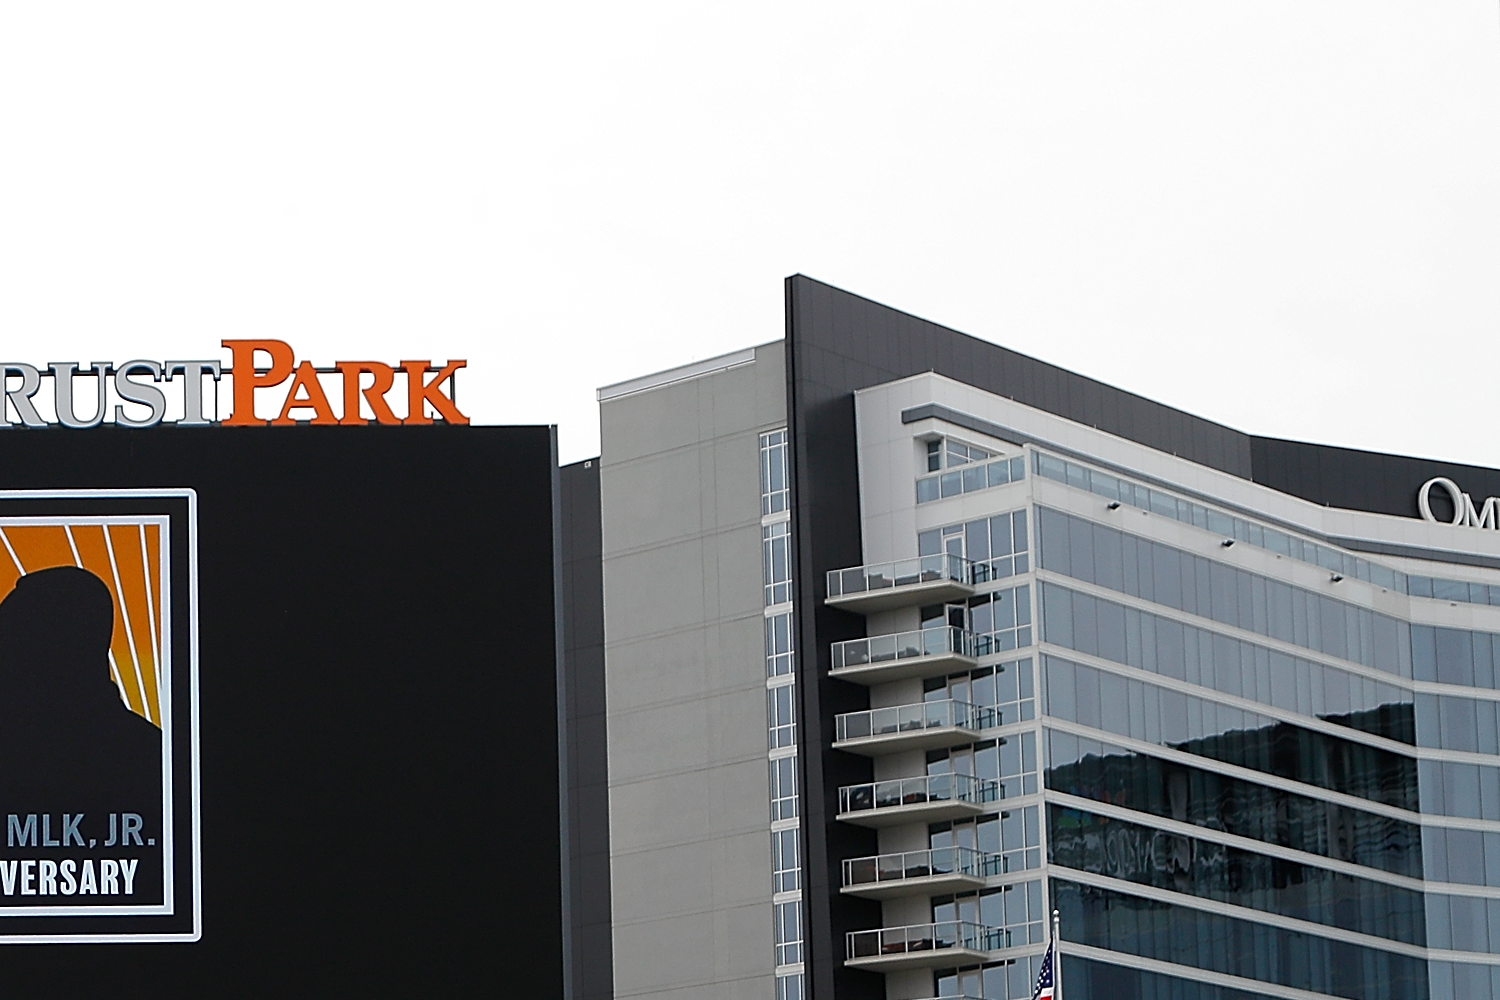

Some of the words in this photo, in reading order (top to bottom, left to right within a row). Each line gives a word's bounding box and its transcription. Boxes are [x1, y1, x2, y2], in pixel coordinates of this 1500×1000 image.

[1418, 476, 1500, 530] OM
[7, 814, 97, 849] MLK,
[104, 813, 156, 846] JR.
